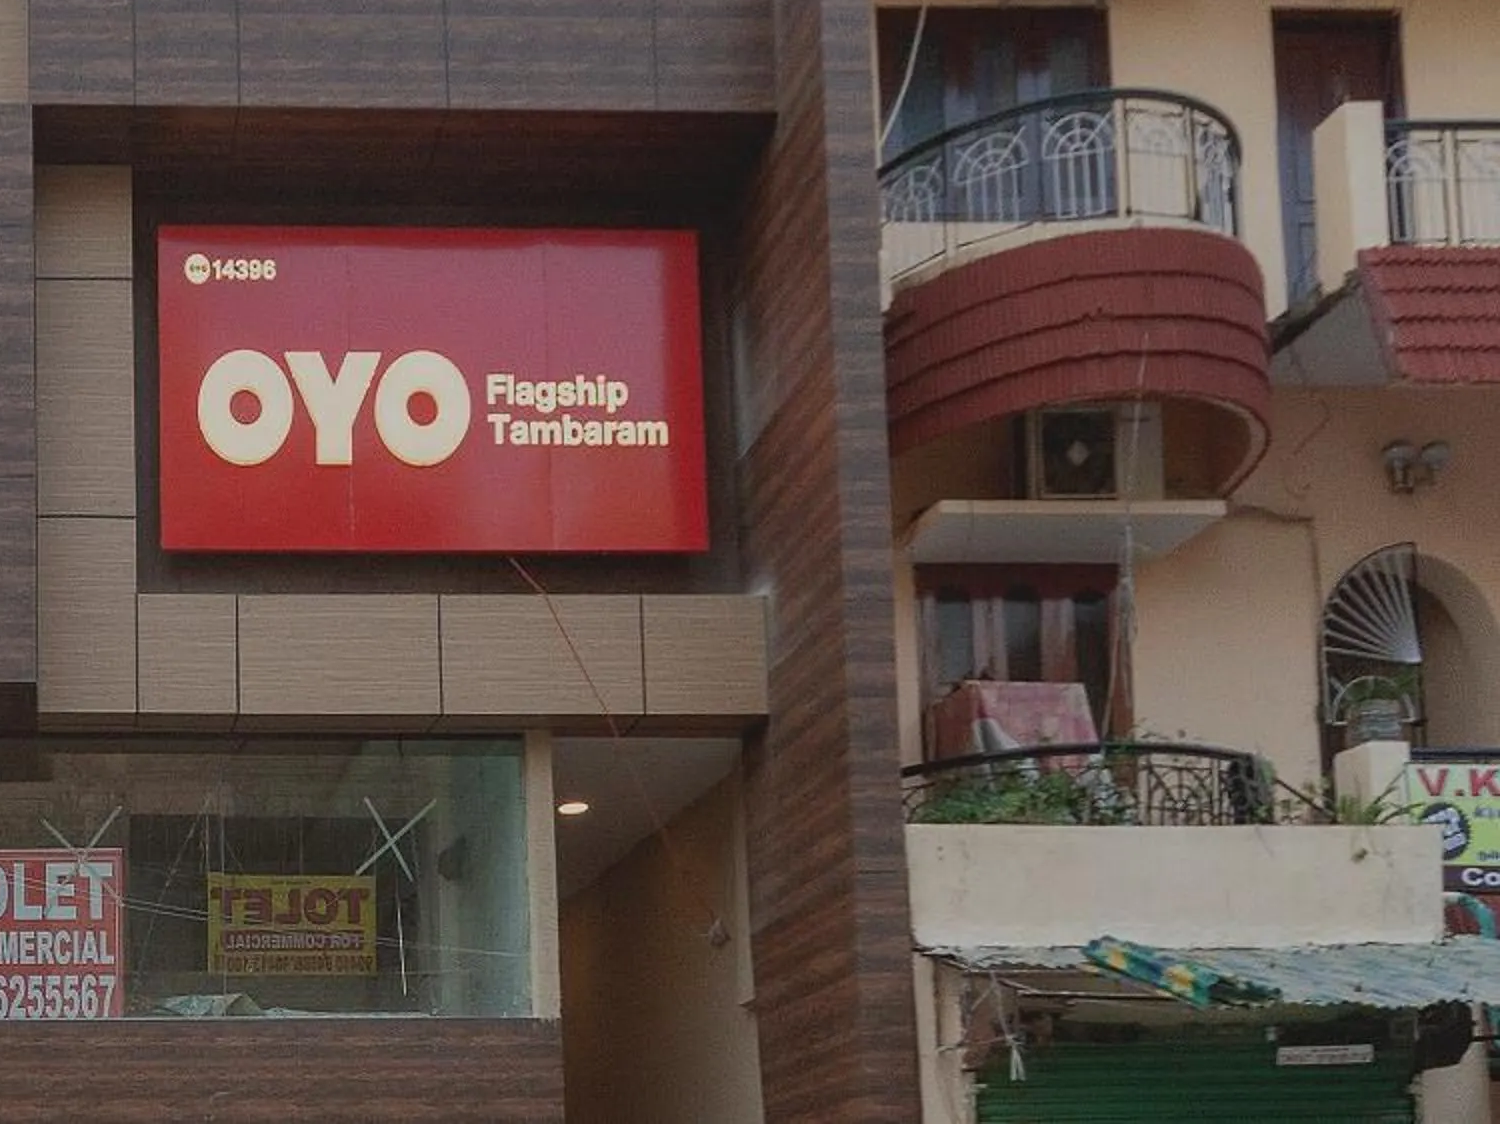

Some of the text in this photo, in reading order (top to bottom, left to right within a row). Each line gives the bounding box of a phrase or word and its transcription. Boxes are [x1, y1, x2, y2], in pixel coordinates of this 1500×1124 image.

[197, 349, 472, 466] OYO
[486, 373, 629, 413] Flagship
[486, 413, 669, 447] Tambaram
